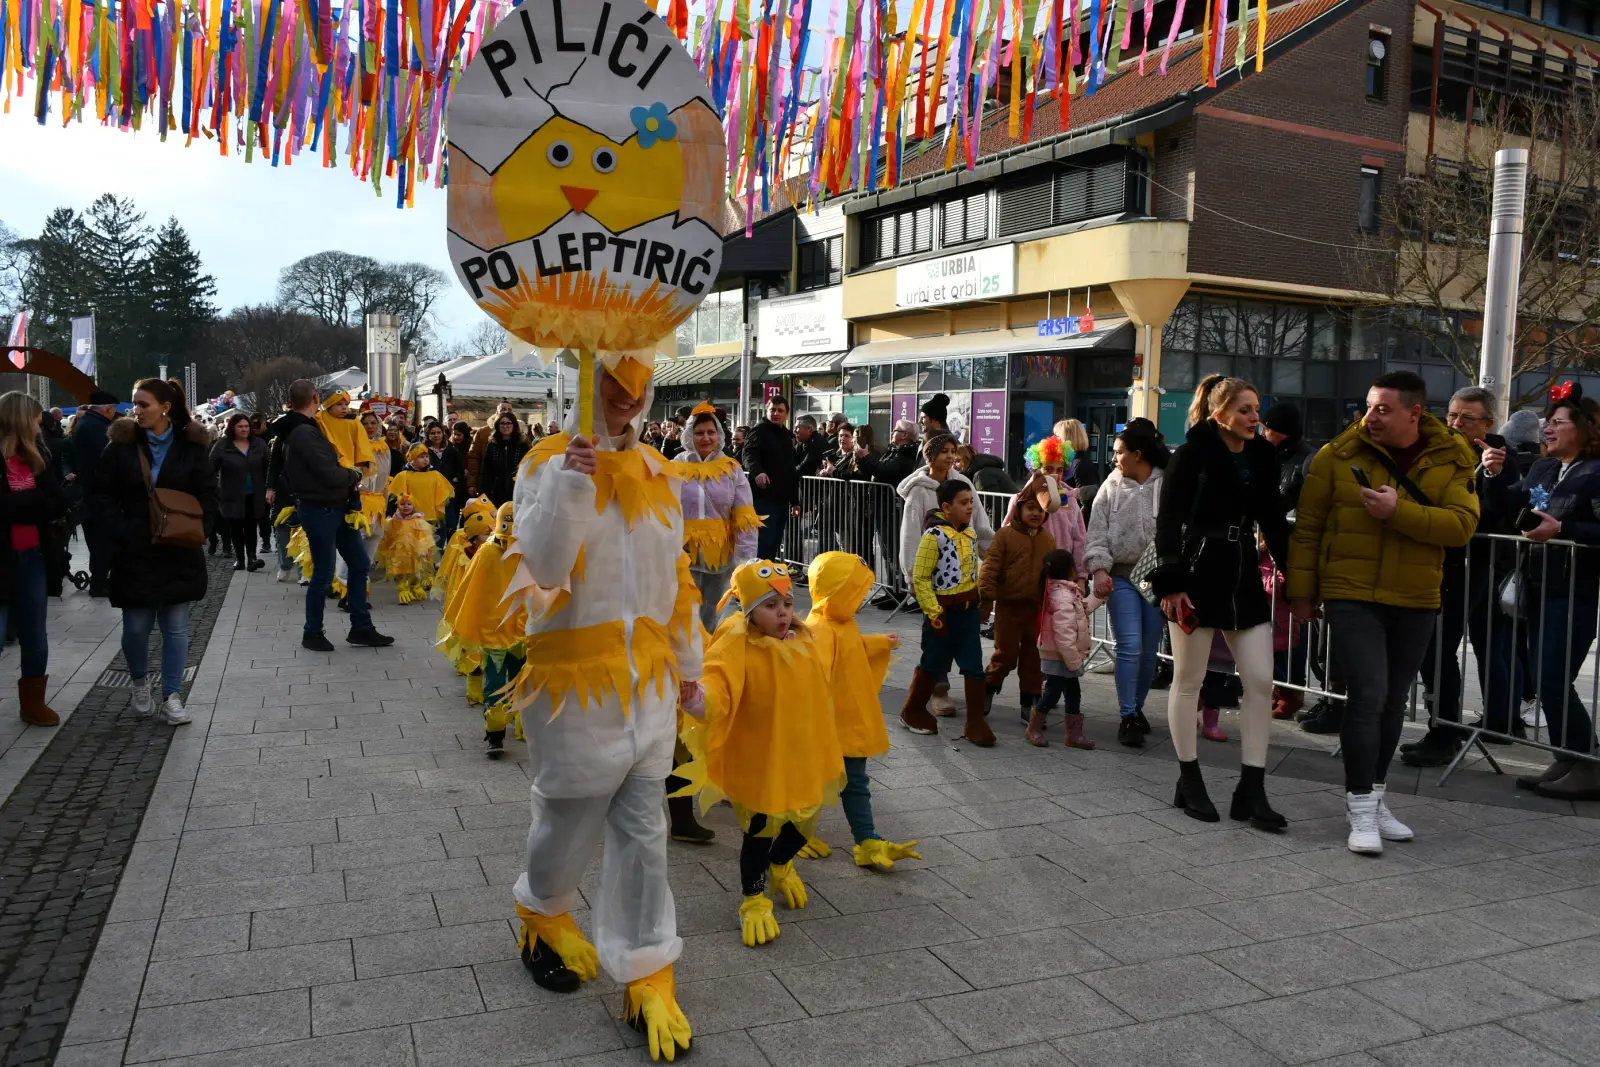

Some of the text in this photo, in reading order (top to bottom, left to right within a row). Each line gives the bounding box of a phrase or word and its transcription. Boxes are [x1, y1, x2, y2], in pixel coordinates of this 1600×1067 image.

[480, 0, 672, 98] PILIĆI
[460, 232, 714, 299] PO LEPTIRIĆ
[941, 256, 976, 277] URBIA
[906, 274, 1000, 304] urbi et orbi 25
[1038, 316, 1079, 337] ERSTE
